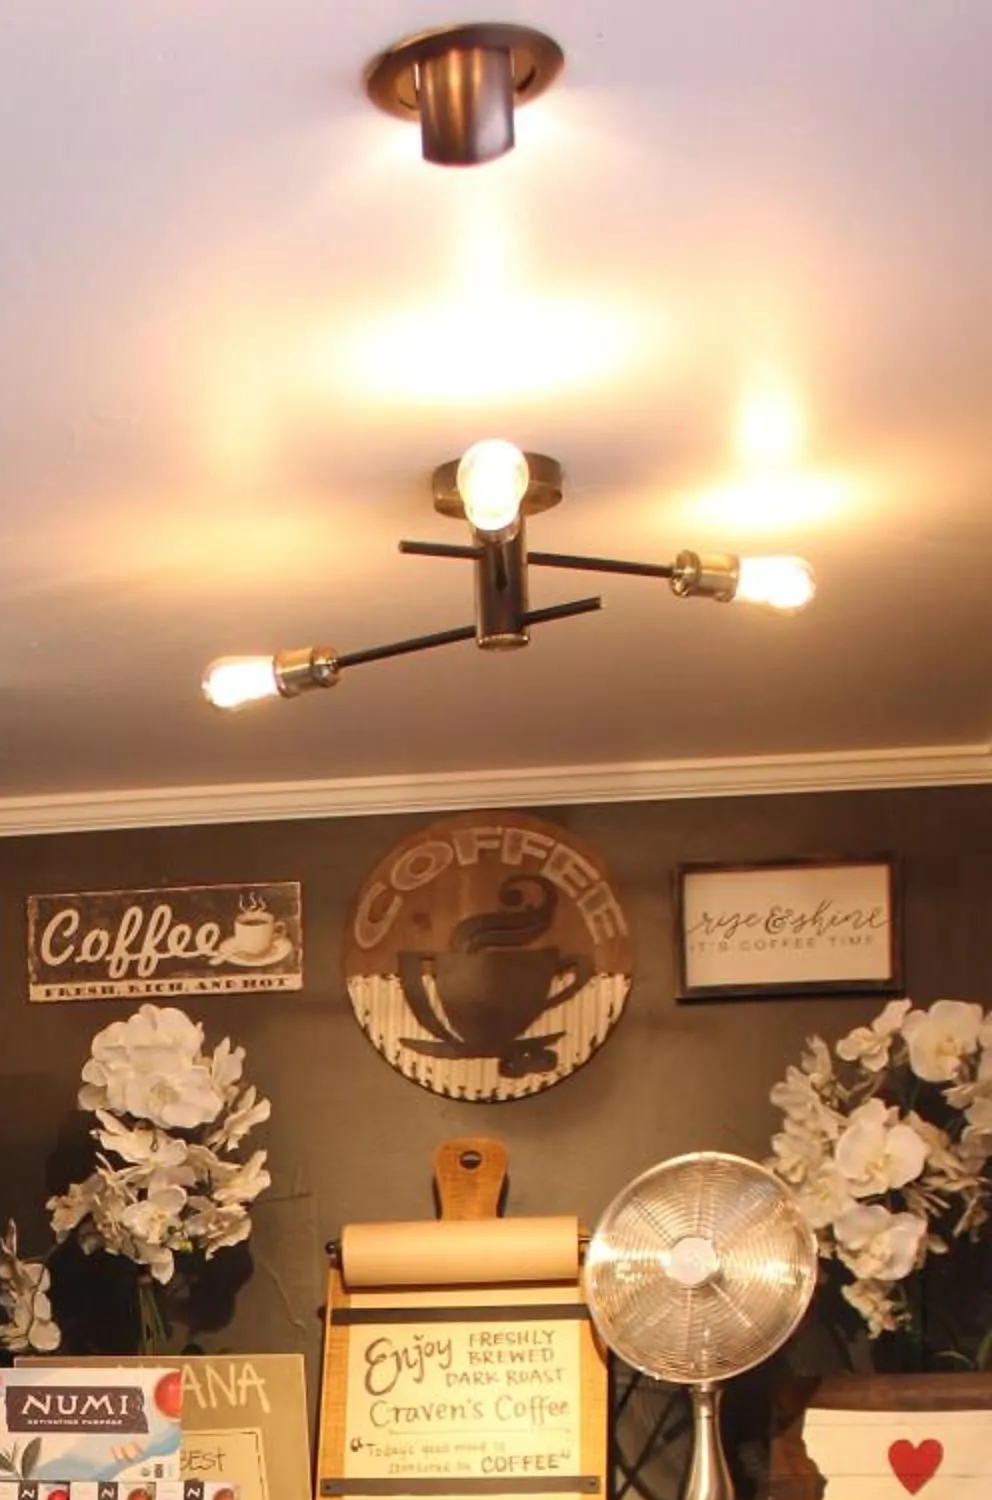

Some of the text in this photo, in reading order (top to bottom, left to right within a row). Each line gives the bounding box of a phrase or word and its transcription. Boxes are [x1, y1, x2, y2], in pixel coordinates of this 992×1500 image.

[354, 826, 628, 948] COFFEE
[41, 904, 231, 979] Coffee
[739, 936, 816, 951] COFFEE
[829, 934, 874, 947] TIME
[44, 981, 121, 998] FRESH,
[196, 978, 236, 992] AND
[241, 977, 289, 990] HOT
[364, 1328, 557, 1397] Enjoy FRESHLY
[468, 1348, 555, 1366] BREWED
[445, 1367, 566, 1388] DARK ROAST
[21, 1393, 129, 1415] NUMI
[369, 1394, 570, 1429] Craven's Coffee
